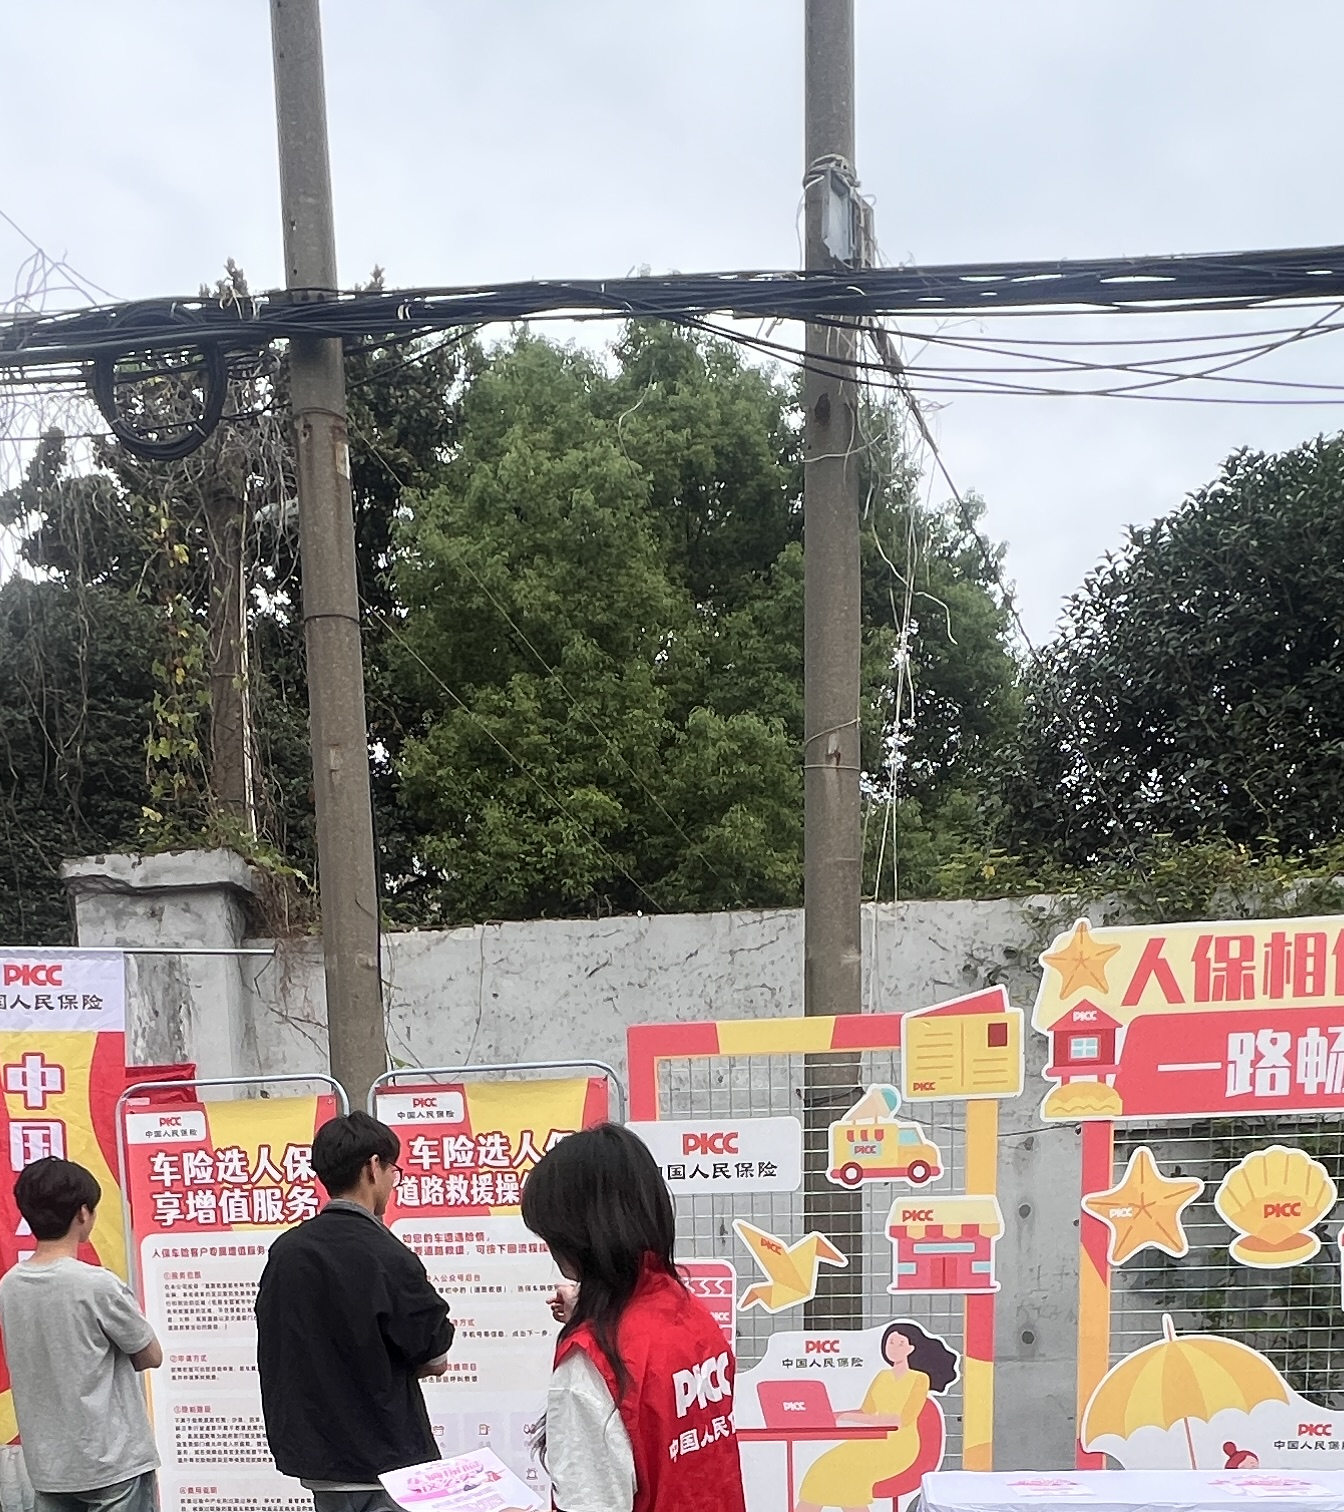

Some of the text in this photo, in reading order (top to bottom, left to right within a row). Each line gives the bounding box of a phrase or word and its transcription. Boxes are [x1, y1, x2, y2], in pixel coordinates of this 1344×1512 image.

[3, 964, 62, 986] PICC
[1073, 1010, 1097, 1022] PICC
[913, 1082, 936, 1092] PICC
[413, 1098, 437, 1107] PICC
[159, 1117, 182, 1127] PICC
[683, 1132, 738, 1155] PICC
[854, 1145, 876, 1154] PICC
[150, 1144, 316, 1187] 车险选人保
[396, 1173, 528, 1207] 道路救援操
[152, 1186, 319, 1227] 享增值服务
[1109, 1207, 1132, 1218] PICC
[1264, 1202, 1301, 1218] PICC
[902, 1209, 934, 1222] PICC
[760, 1237, 783, 1255] PICC
[805, 1340, 840, 1353] PICC
[782, 1358, 864, 1368] 中国人民保险
[673, 1352, 732, 1419] PICC
[783, 1401, 807, 1411] PICC
[1298, 1423, 1332, 1436] PICC
[669, 1411, 736, 1463] 中国人民
